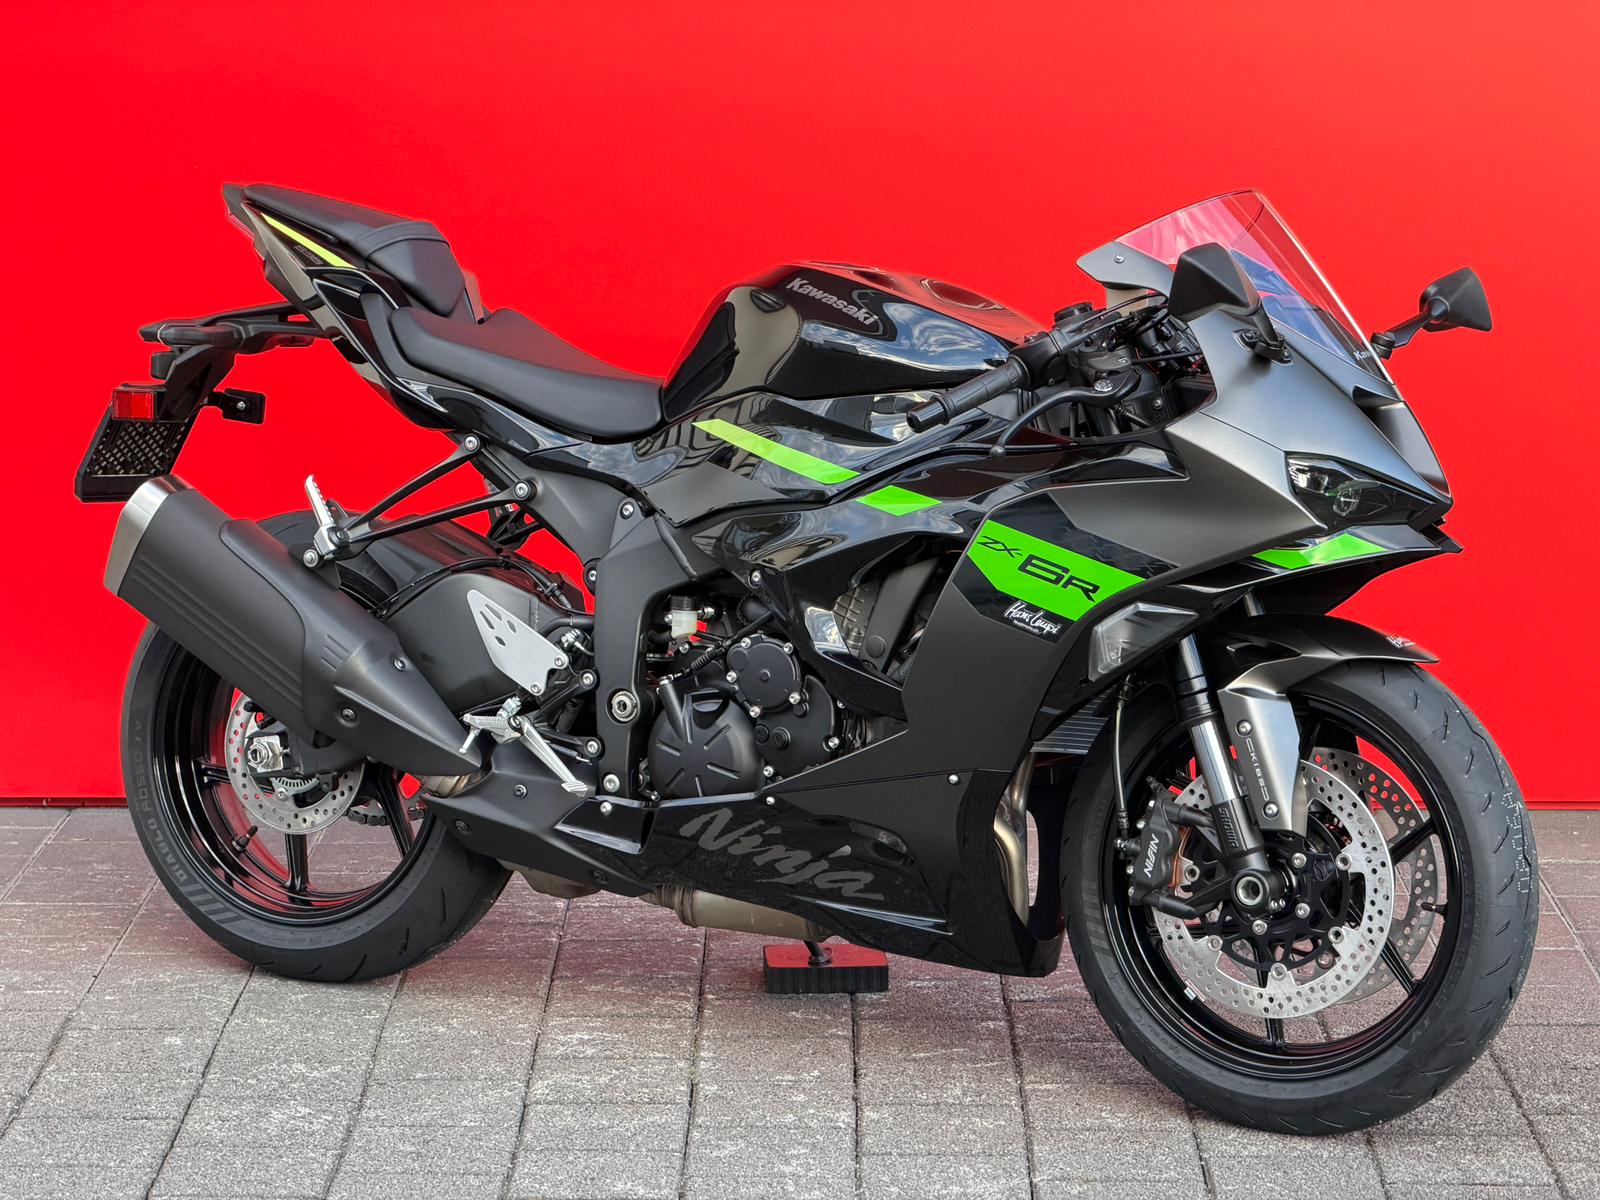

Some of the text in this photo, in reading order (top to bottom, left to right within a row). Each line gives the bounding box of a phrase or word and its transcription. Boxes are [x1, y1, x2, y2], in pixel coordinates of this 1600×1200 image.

[785, 277, 879, 325] Kawasaki
[147, 815, 187, 883] DIABLO
[1218, 807, 1239, 848] SHOWA
[678, 807, 885, 901] Ninja
[1143, 833, 1160, 878] NISSIN
